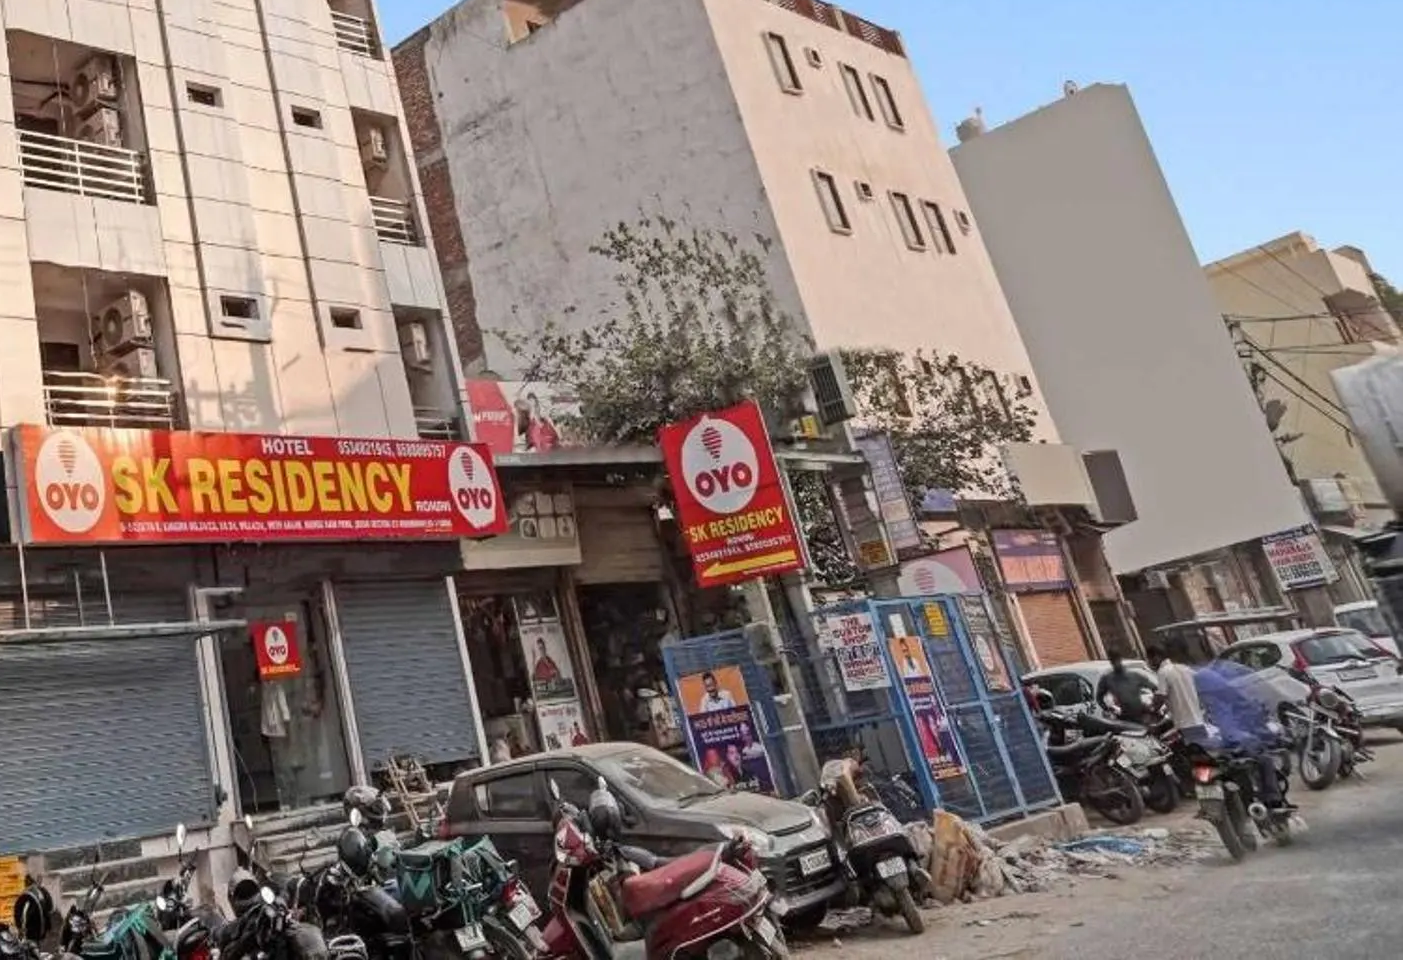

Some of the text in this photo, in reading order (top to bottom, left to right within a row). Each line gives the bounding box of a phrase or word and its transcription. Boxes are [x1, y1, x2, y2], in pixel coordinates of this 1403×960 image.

[261, 438, 314, 455] HOTEL
[112, 456, 413, 514] SK RESIDENCY
[695, 462, 753, 498] OYO
[46, 482, 100, 511] OYO
[457, 487, 492, 510] OYO
[689, 524, 708, 543] SK
[709, 506, 784, 538] RESIDENCY
[269, 645, 286, 656] OYO
